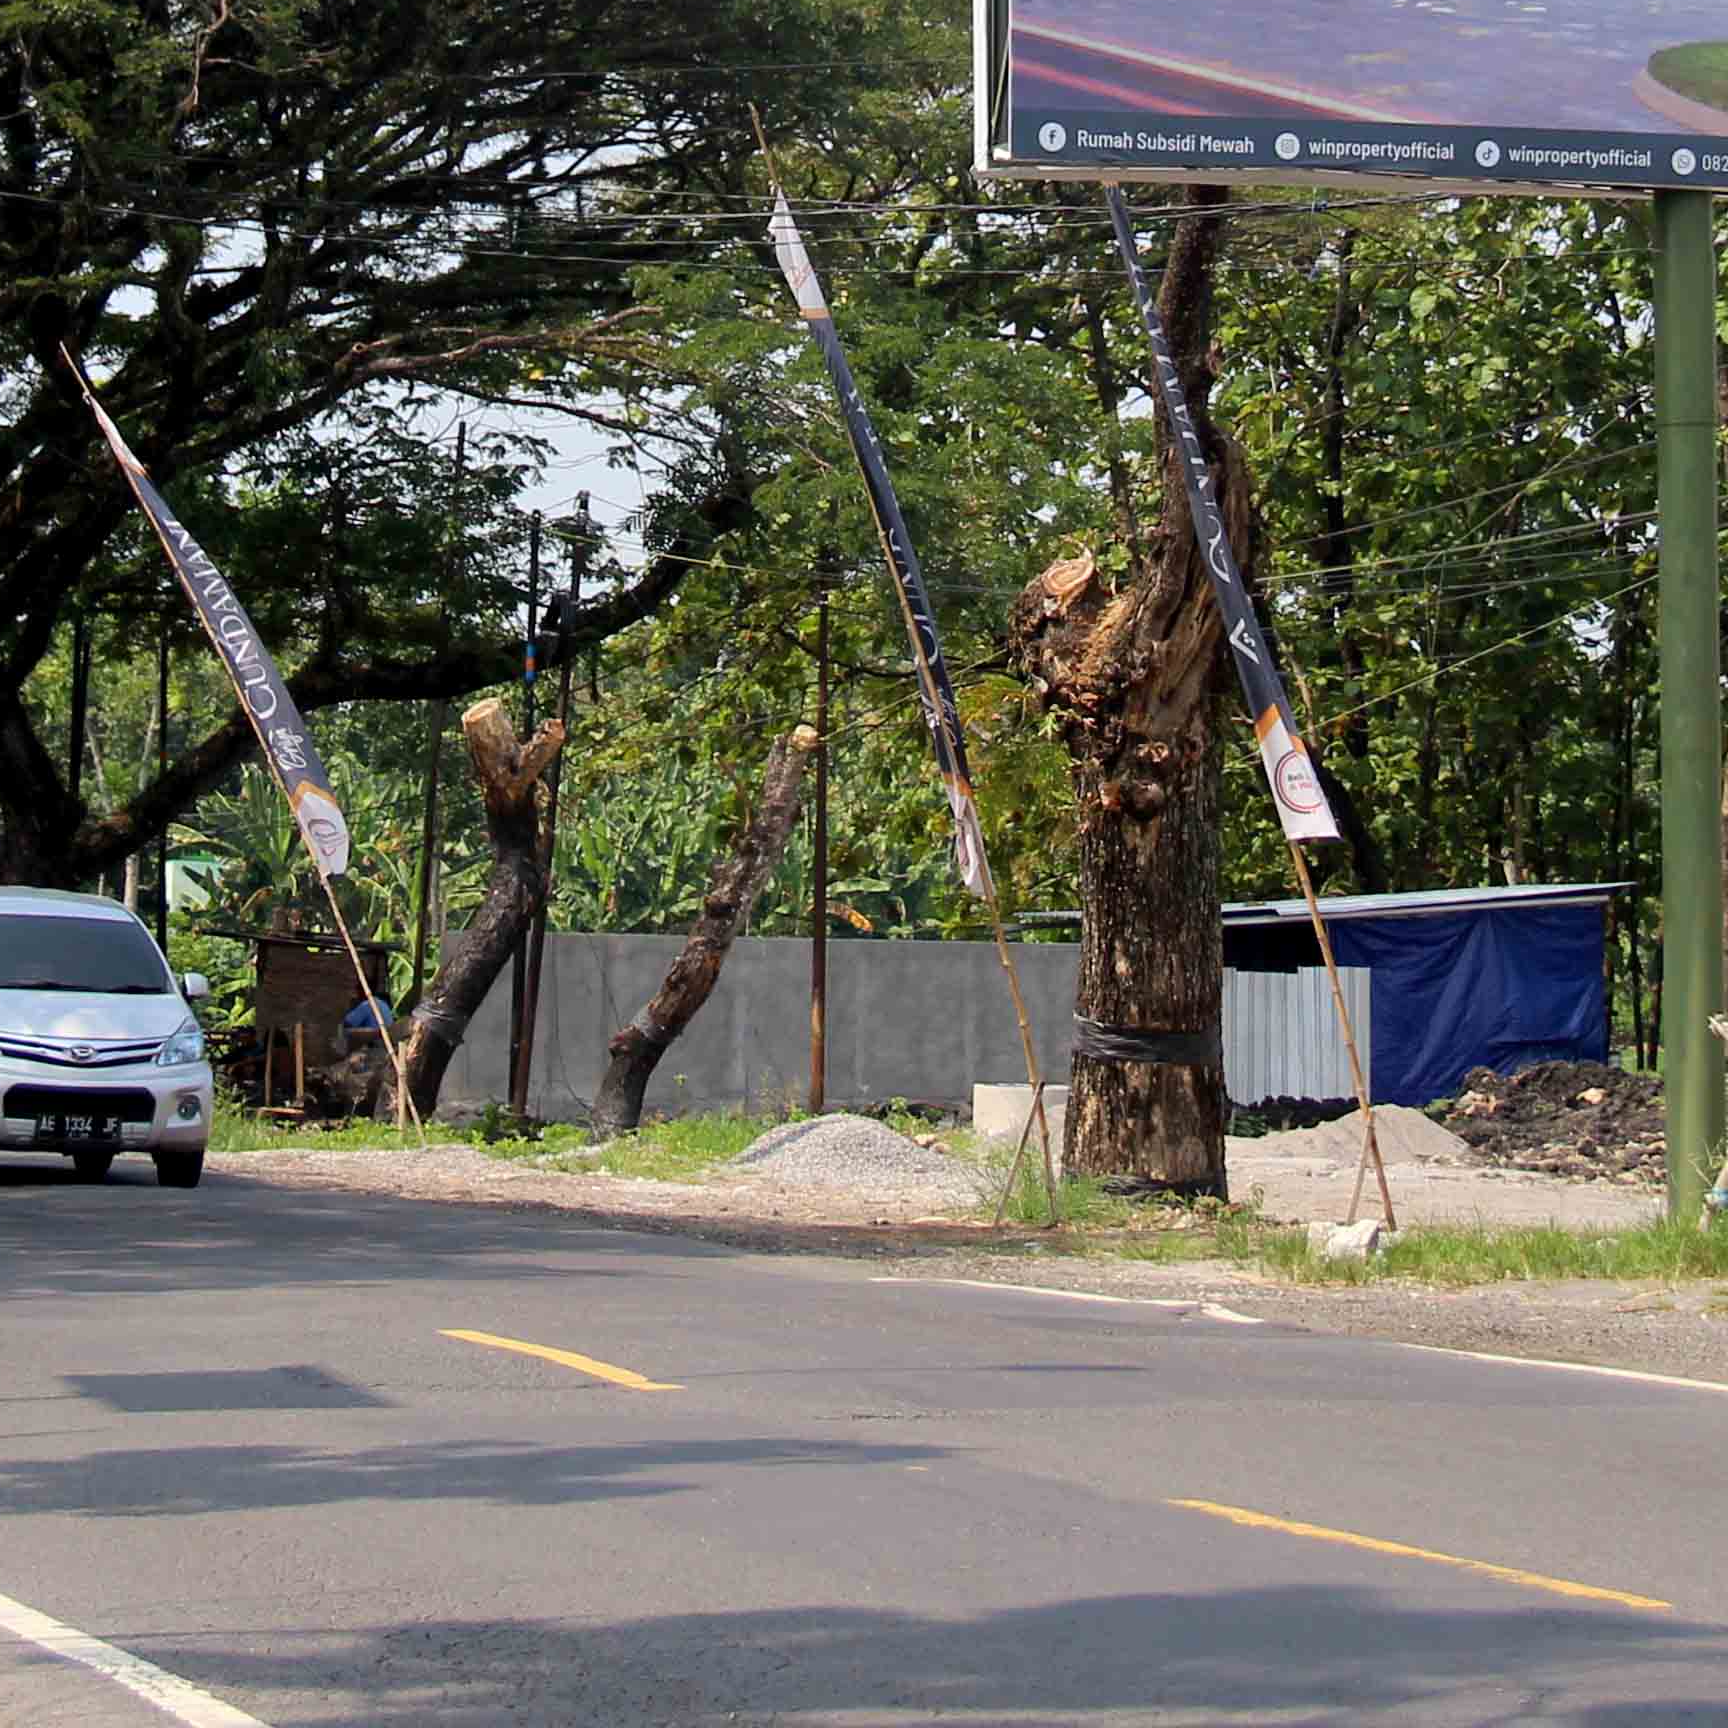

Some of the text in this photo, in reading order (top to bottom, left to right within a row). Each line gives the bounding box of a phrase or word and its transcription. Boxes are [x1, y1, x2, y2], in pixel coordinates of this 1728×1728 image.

[1076, 129, 1255, 156] Rumah Subsidi Mewah
[1307, 137, 1456, 163] winpropertyofficial
[1507, 145, 1652, 170] winpropertyofficial
